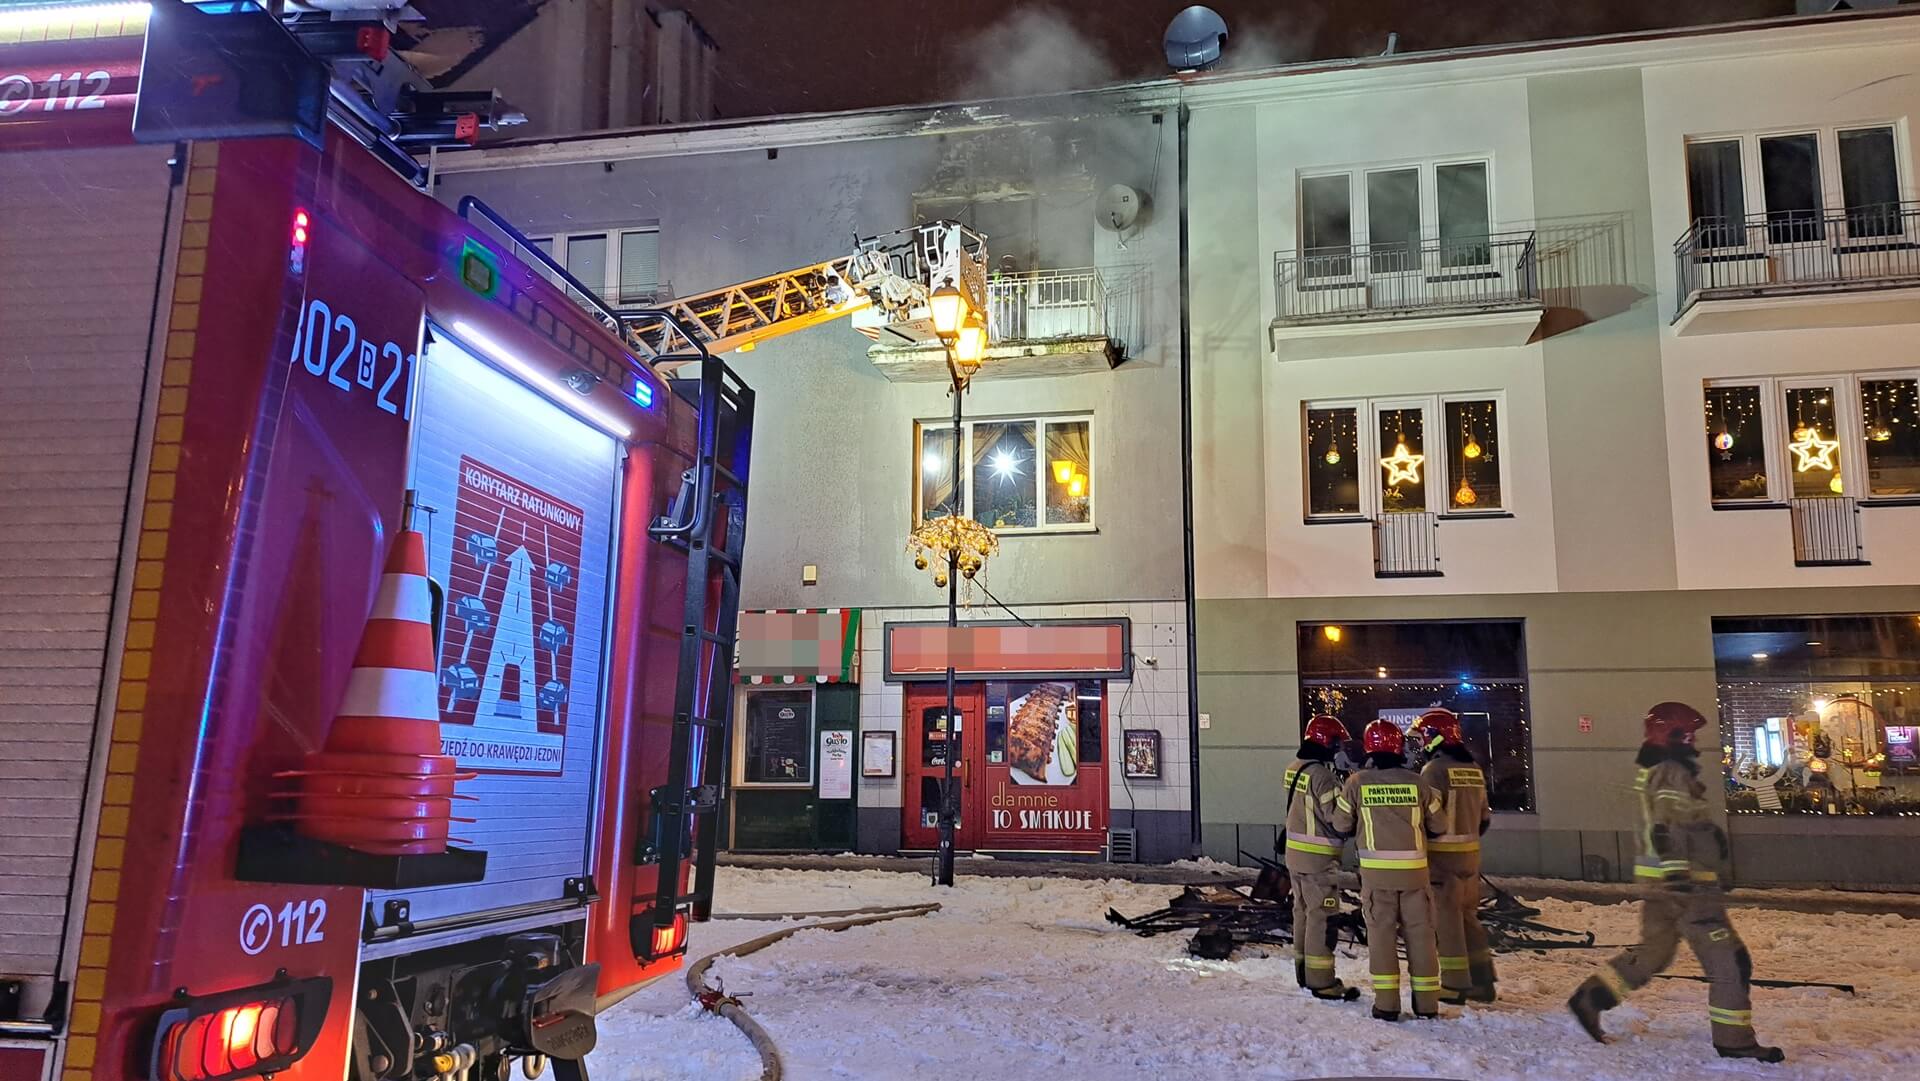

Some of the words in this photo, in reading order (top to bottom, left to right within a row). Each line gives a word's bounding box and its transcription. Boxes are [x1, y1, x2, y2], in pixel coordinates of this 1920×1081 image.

[40, 71, 111, 111] 112
[465, 466, 520, 506] KORYTARZ
[521, 492, 581, 531] RATUNKOWY
[469, 743, 485, 758] DO
[486, 744, 533, 763] KRAWĘDZI
[533, 747, 561, 762] JEZDNI
[991, 781, 1015, 807] dla
[1018, 793, 1058, 807] mnie
[992, 809, 1012, 829] TO
[1019, 810, 1092, 830] SMAKUJE
[277, 898, 327, 947] 112
